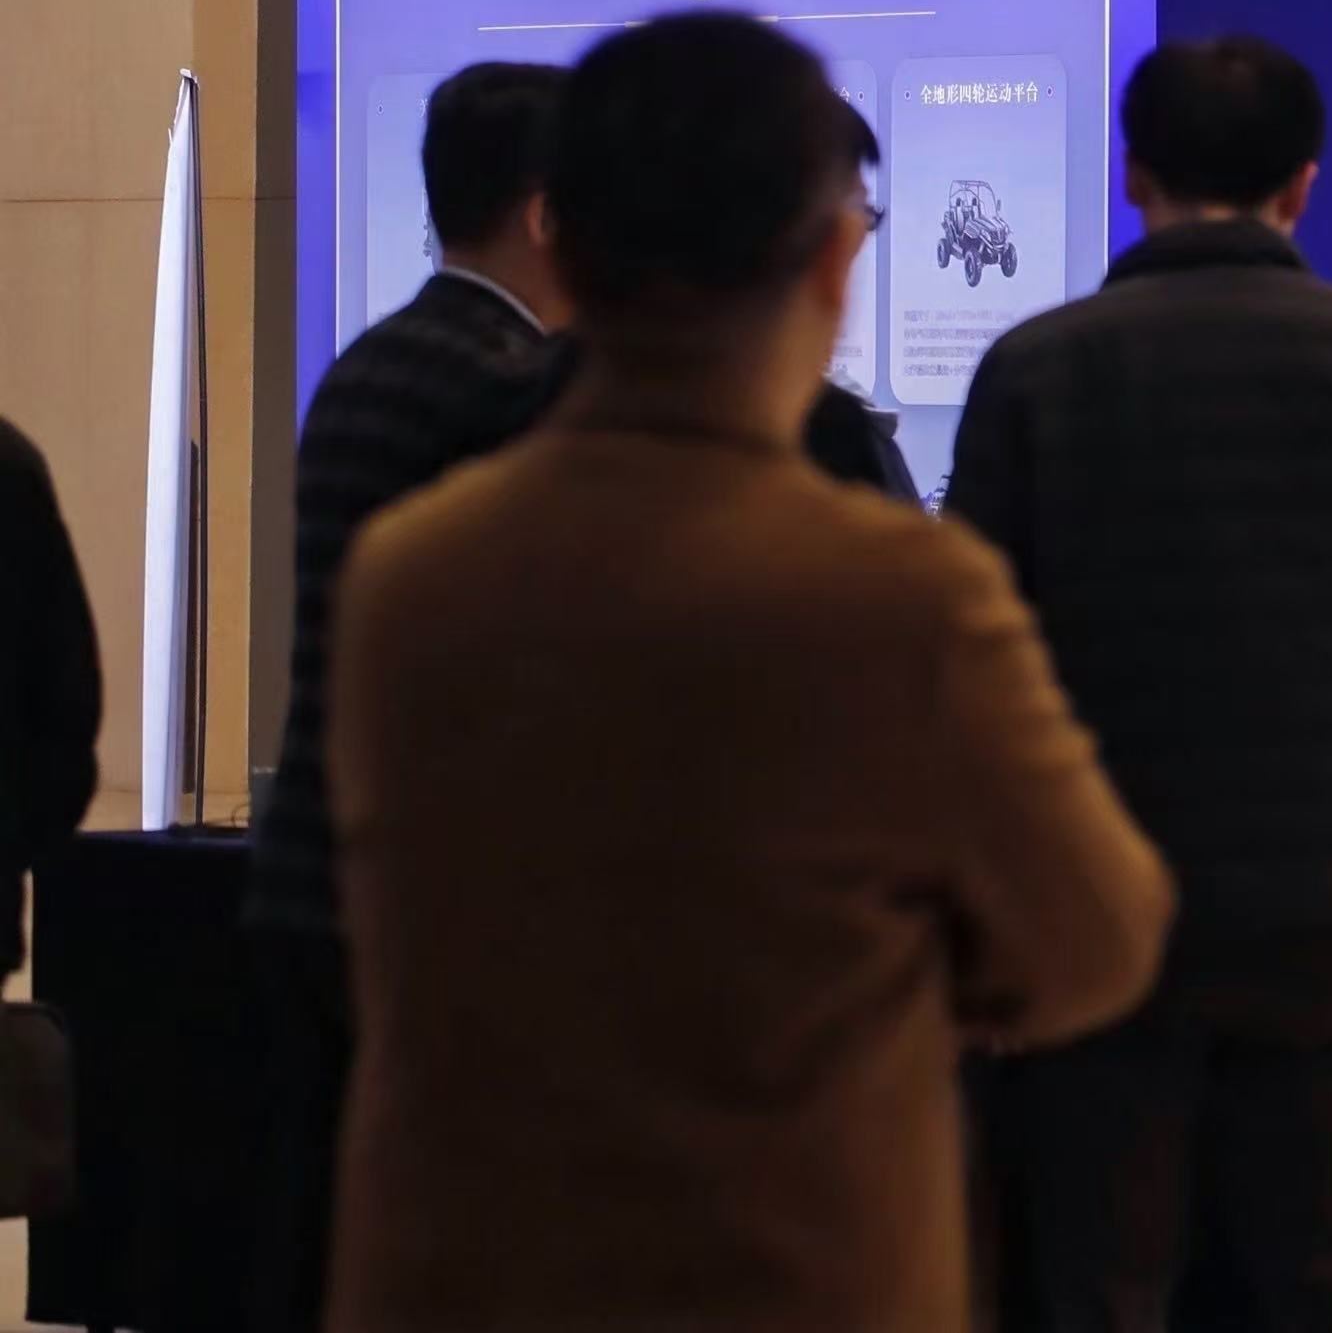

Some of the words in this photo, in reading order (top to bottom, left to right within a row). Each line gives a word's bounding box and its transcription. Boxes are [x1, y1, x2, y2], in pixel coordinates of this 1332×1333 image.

[920, 81, 1039, 107] 全地形四轮运动平台
